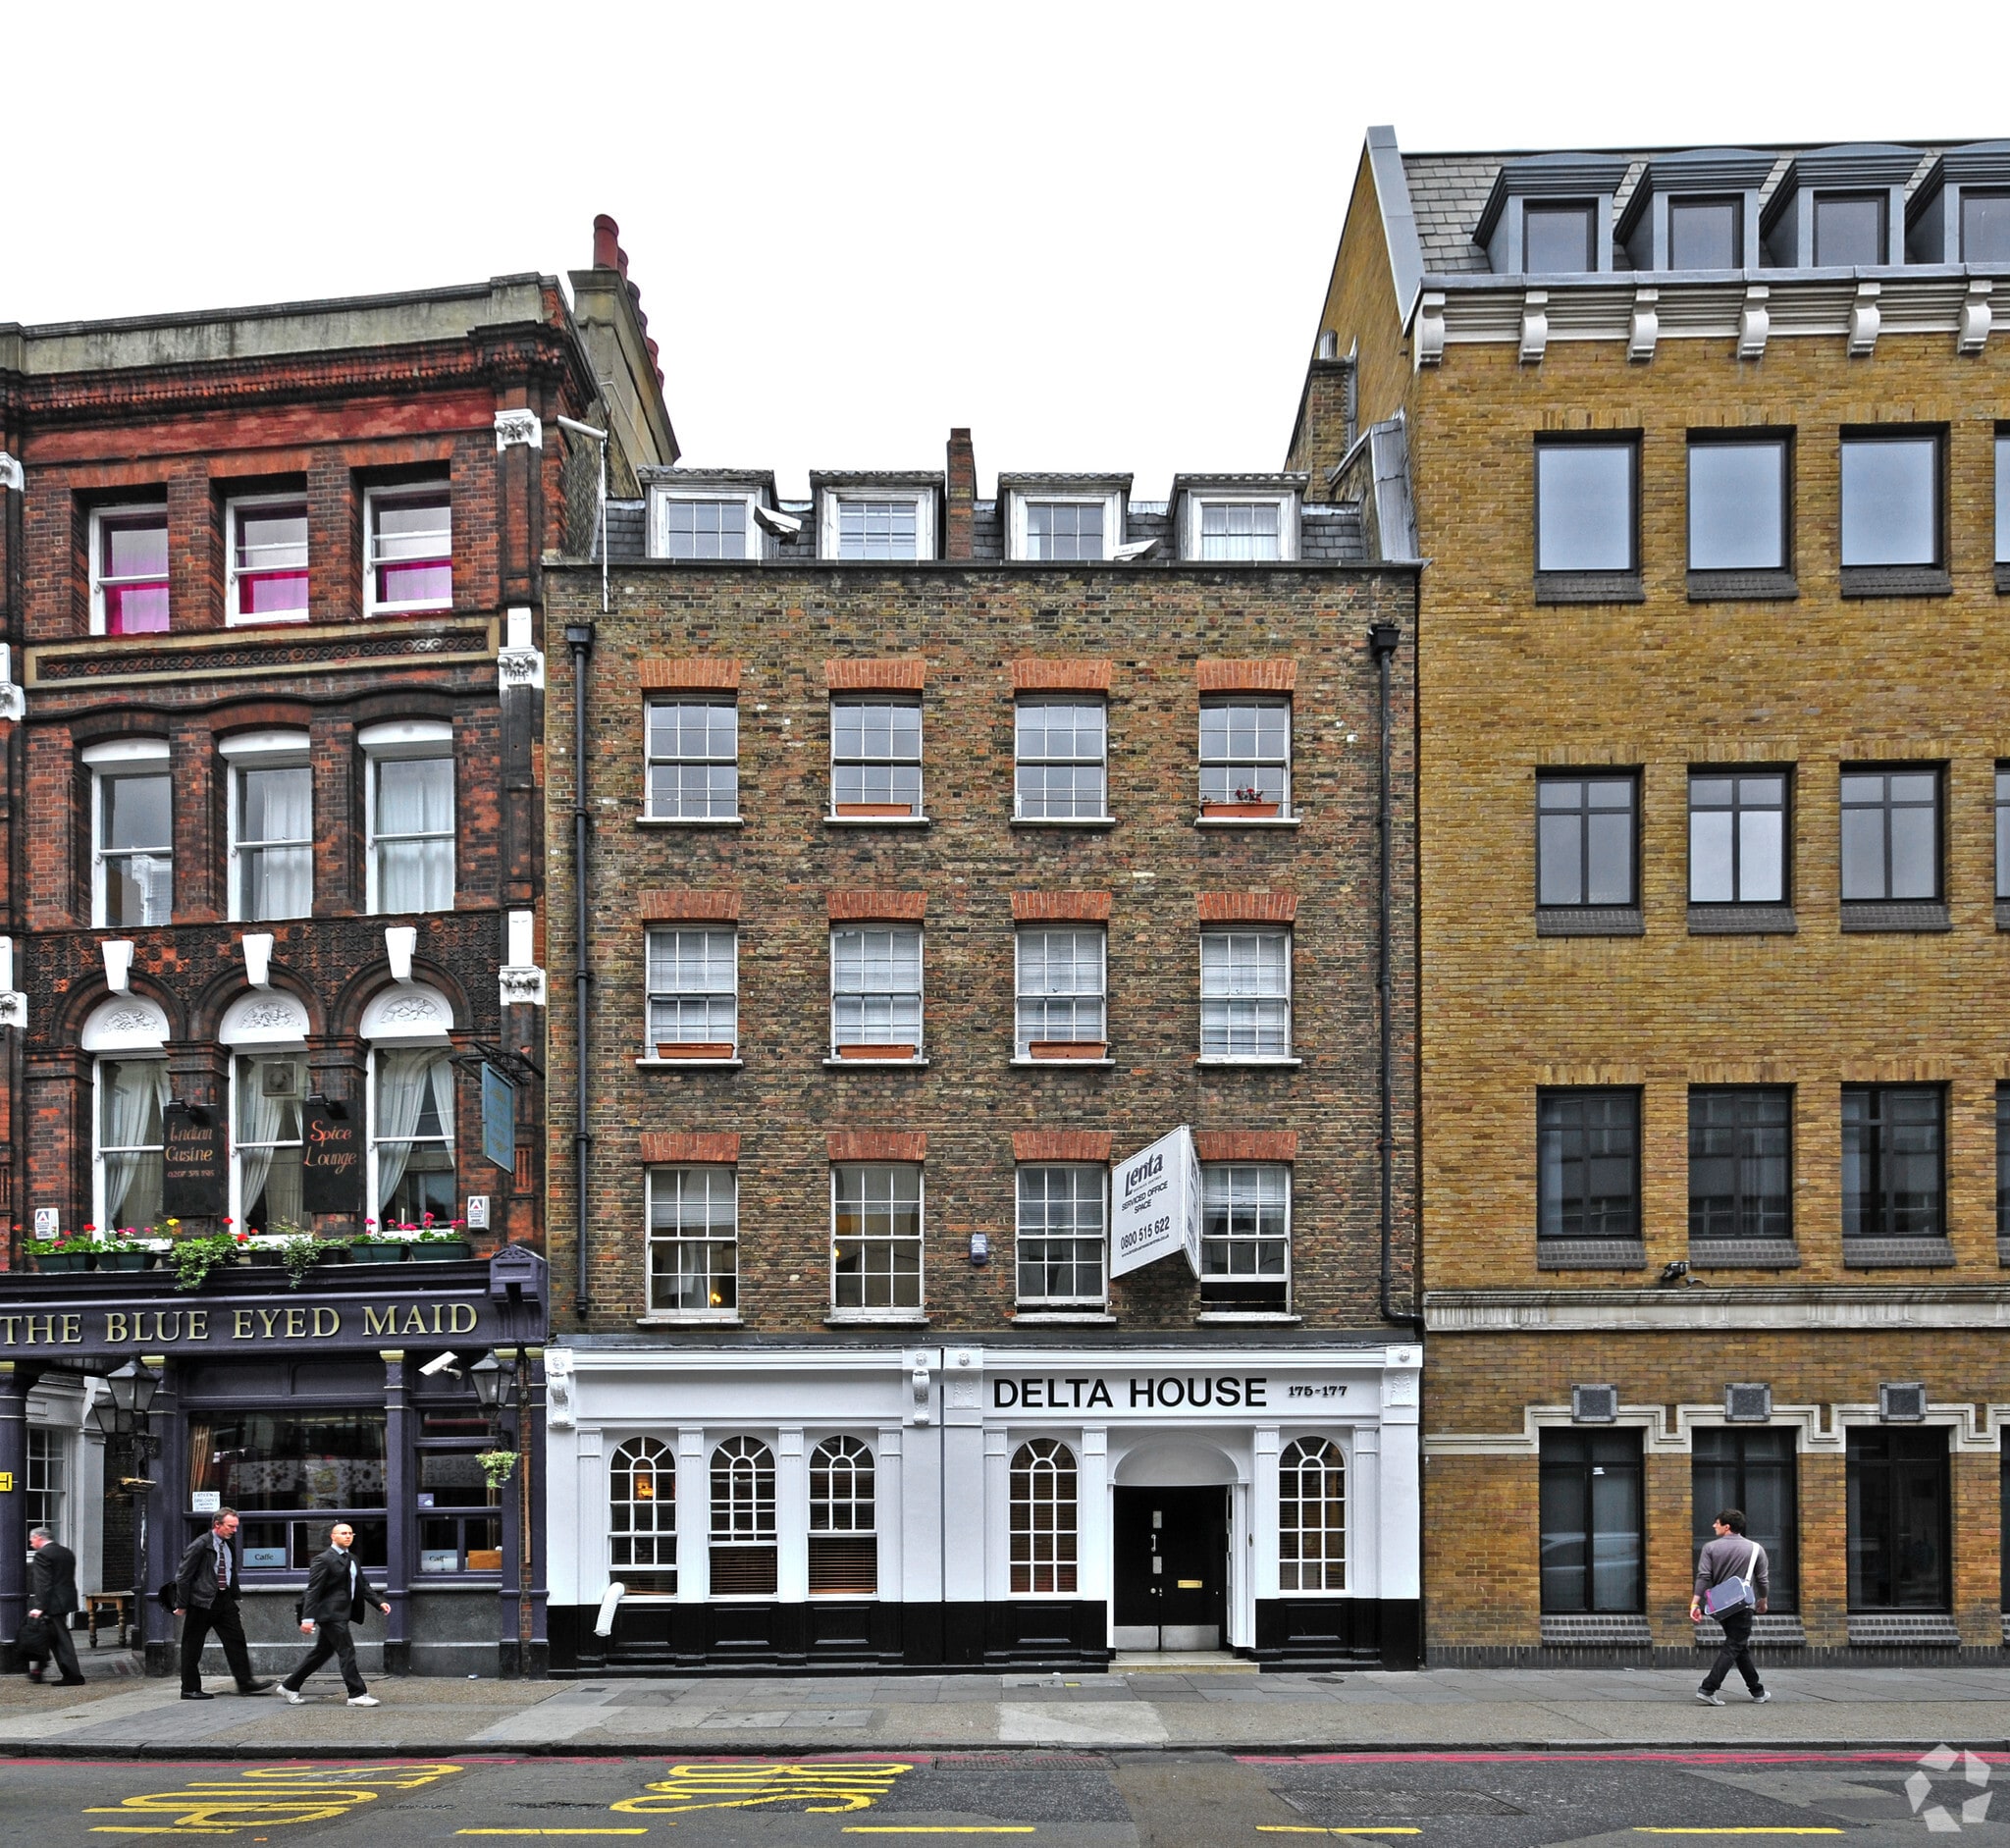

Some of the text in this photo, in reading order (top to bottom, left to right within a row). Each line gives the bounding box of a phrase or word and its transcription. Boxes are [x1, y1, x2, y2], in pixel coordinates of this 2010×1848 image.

[170, 1122, 213, 1141] Indian
[310, 1120, 352, 1147] Spice
[165, 1146, 213, 1162] Cusine
[303, 1145, 357, 1175] Lounge
[1121, 1191, 1146, 1212] SERVICED
[1147, 1180, 1169, 1197] OFFICE
[1134, 1198, 1152, 1214] SPACE
[1120, 1230, 1137, 1250] 0800
[1138, 1223, 1153, 1241] 515
[1154, 1215, 1170, 1235] 622
[0, 1302, 478, 1345] THE BLUE EYED MAID
[993, 1378, 1114, 1408] DELTA
[1130, 1377, 1268, 1408] HOUSE
[81, 1764, 465, 1827] STOP
[609, 1764, 914, 1814] BUS
